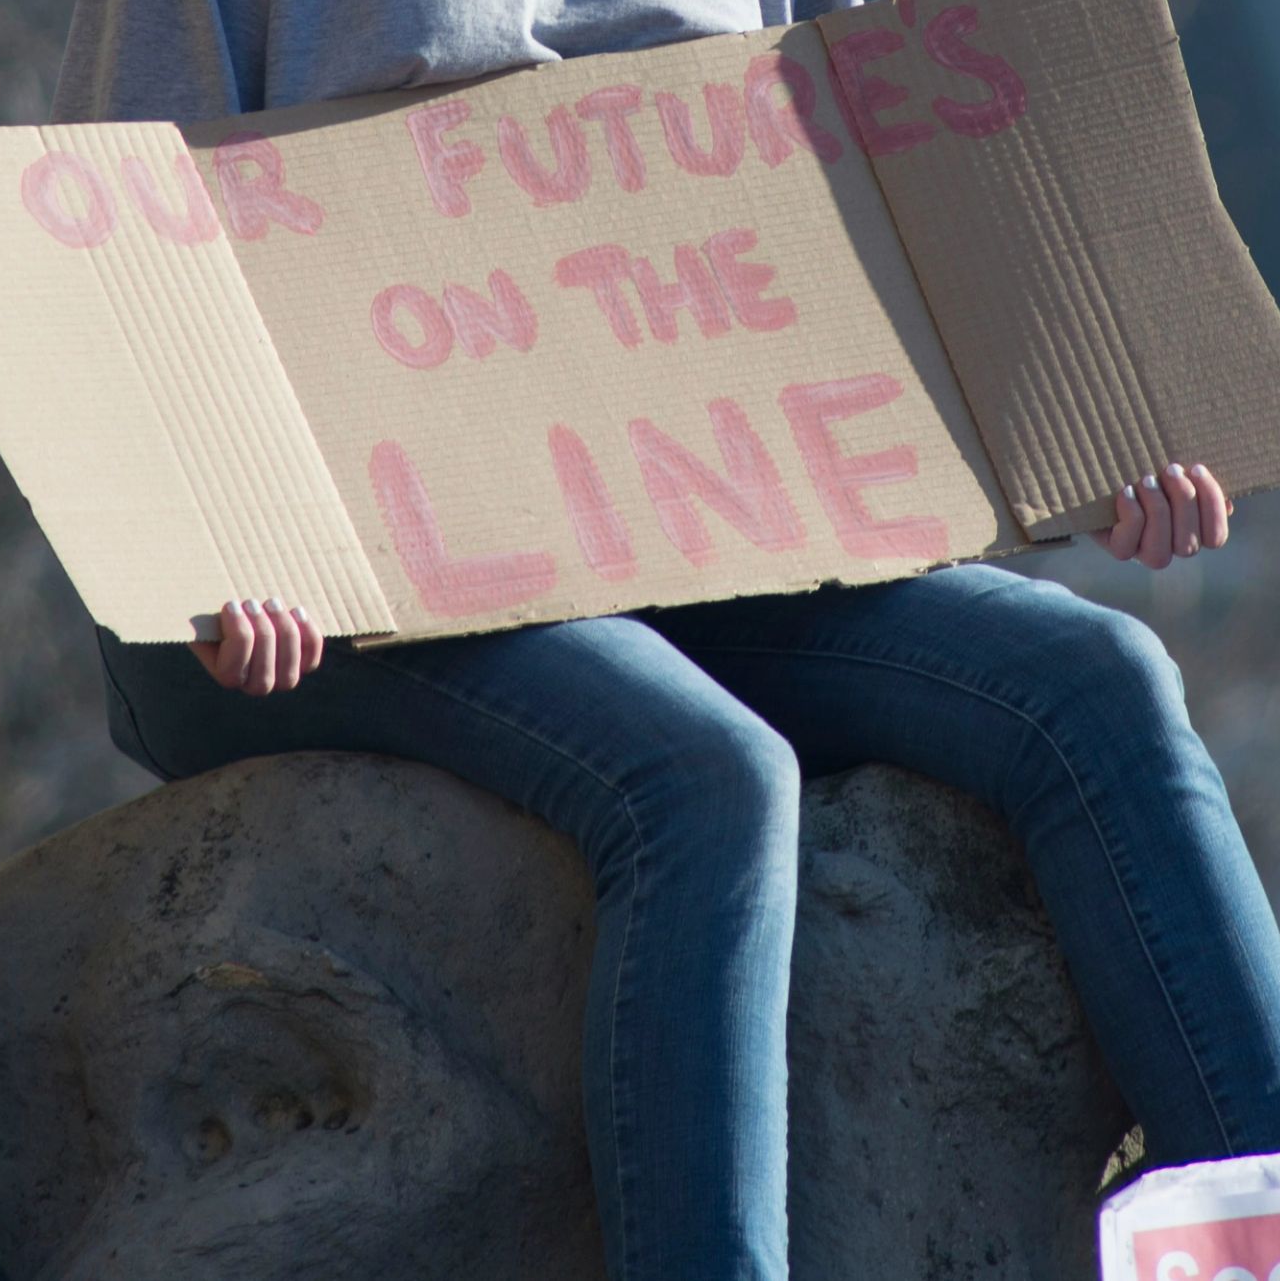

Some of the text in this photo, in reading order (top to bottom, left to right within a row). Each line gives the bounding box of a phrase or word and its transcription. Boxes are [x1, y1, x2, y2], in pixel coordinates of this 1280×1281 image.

[20, 129, 328, 250] OUR
[370, 226, 800, 372] ON THE
[366, 371, 951, 619] LINE
